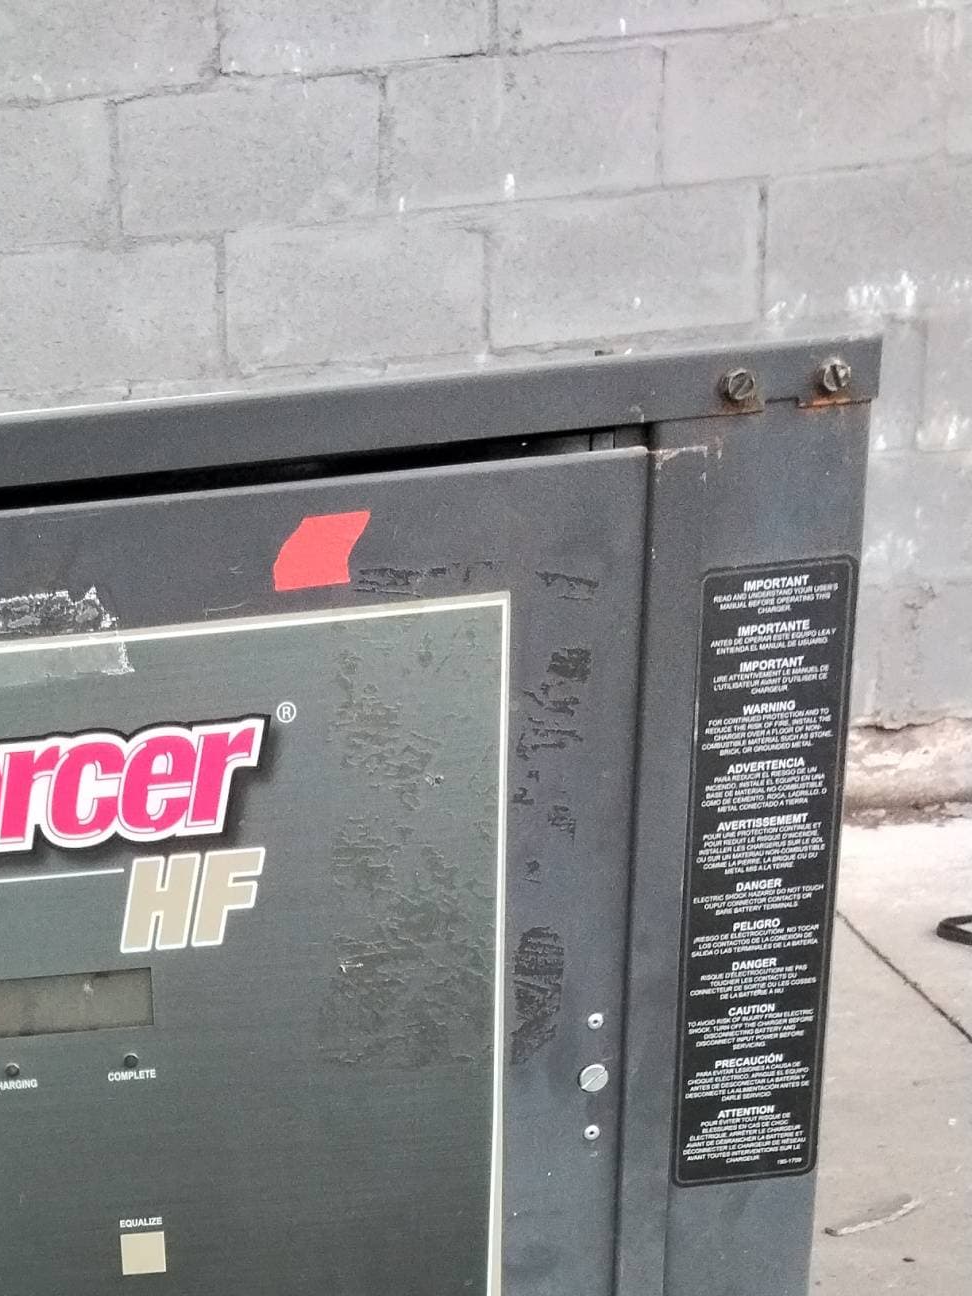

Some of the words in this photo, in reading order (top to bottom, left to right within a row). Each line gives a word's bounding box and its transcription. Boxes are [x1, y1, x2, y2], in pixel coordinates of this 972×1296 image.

[744, 574, 808, 591] IMPORTANT
[738, 619, 810, 636] IMPORTANTE
[740, 656, 803, 672] IMPORTANT
[743, 700, 795, 715] WARNING
[728, 756, 804, 774] ADVERTENCIA
[718, 813, 807, 831] AVERTISSEMEMT
[736, 878, 782, 891] DANGER
[120, 847, 265, 953] HF
[733, 918, 780, 931] PELIGRO
[732, 957, 776, 970] DANGER
[728, 1003, 775, 1016] CAUTION
[715, 1052, 783, 1069] PRECAUCIÓN
[108, 1069, 156, 1082] COMPLETE
[718, 1104, 774, 1118] ATTENTION
[119, 1216, 163, 1228] EQUALIZE
